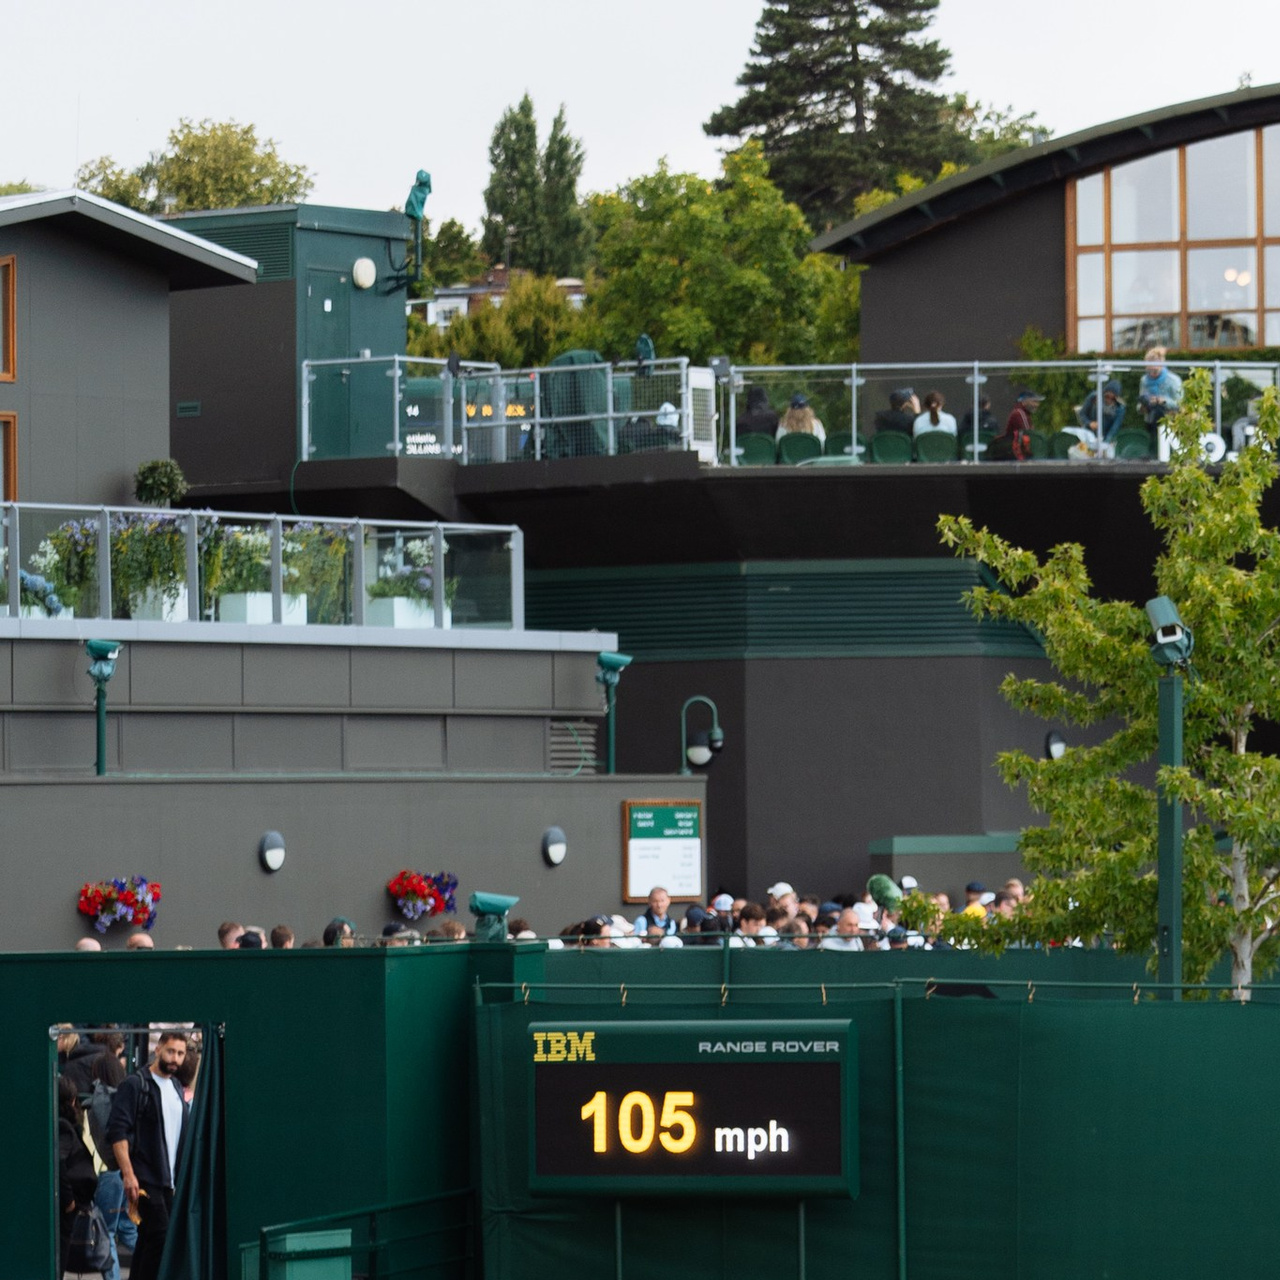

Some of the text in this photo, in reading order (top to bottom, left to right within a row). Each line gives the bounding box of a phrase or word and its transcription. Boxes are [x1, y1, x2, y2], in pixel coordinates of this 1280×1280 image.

[533, 1031, 596, 1062] IBM
[699, 1041, 839, 1053] RANGE ROVER
[580, 1091, 789, 1160] 105 mph
